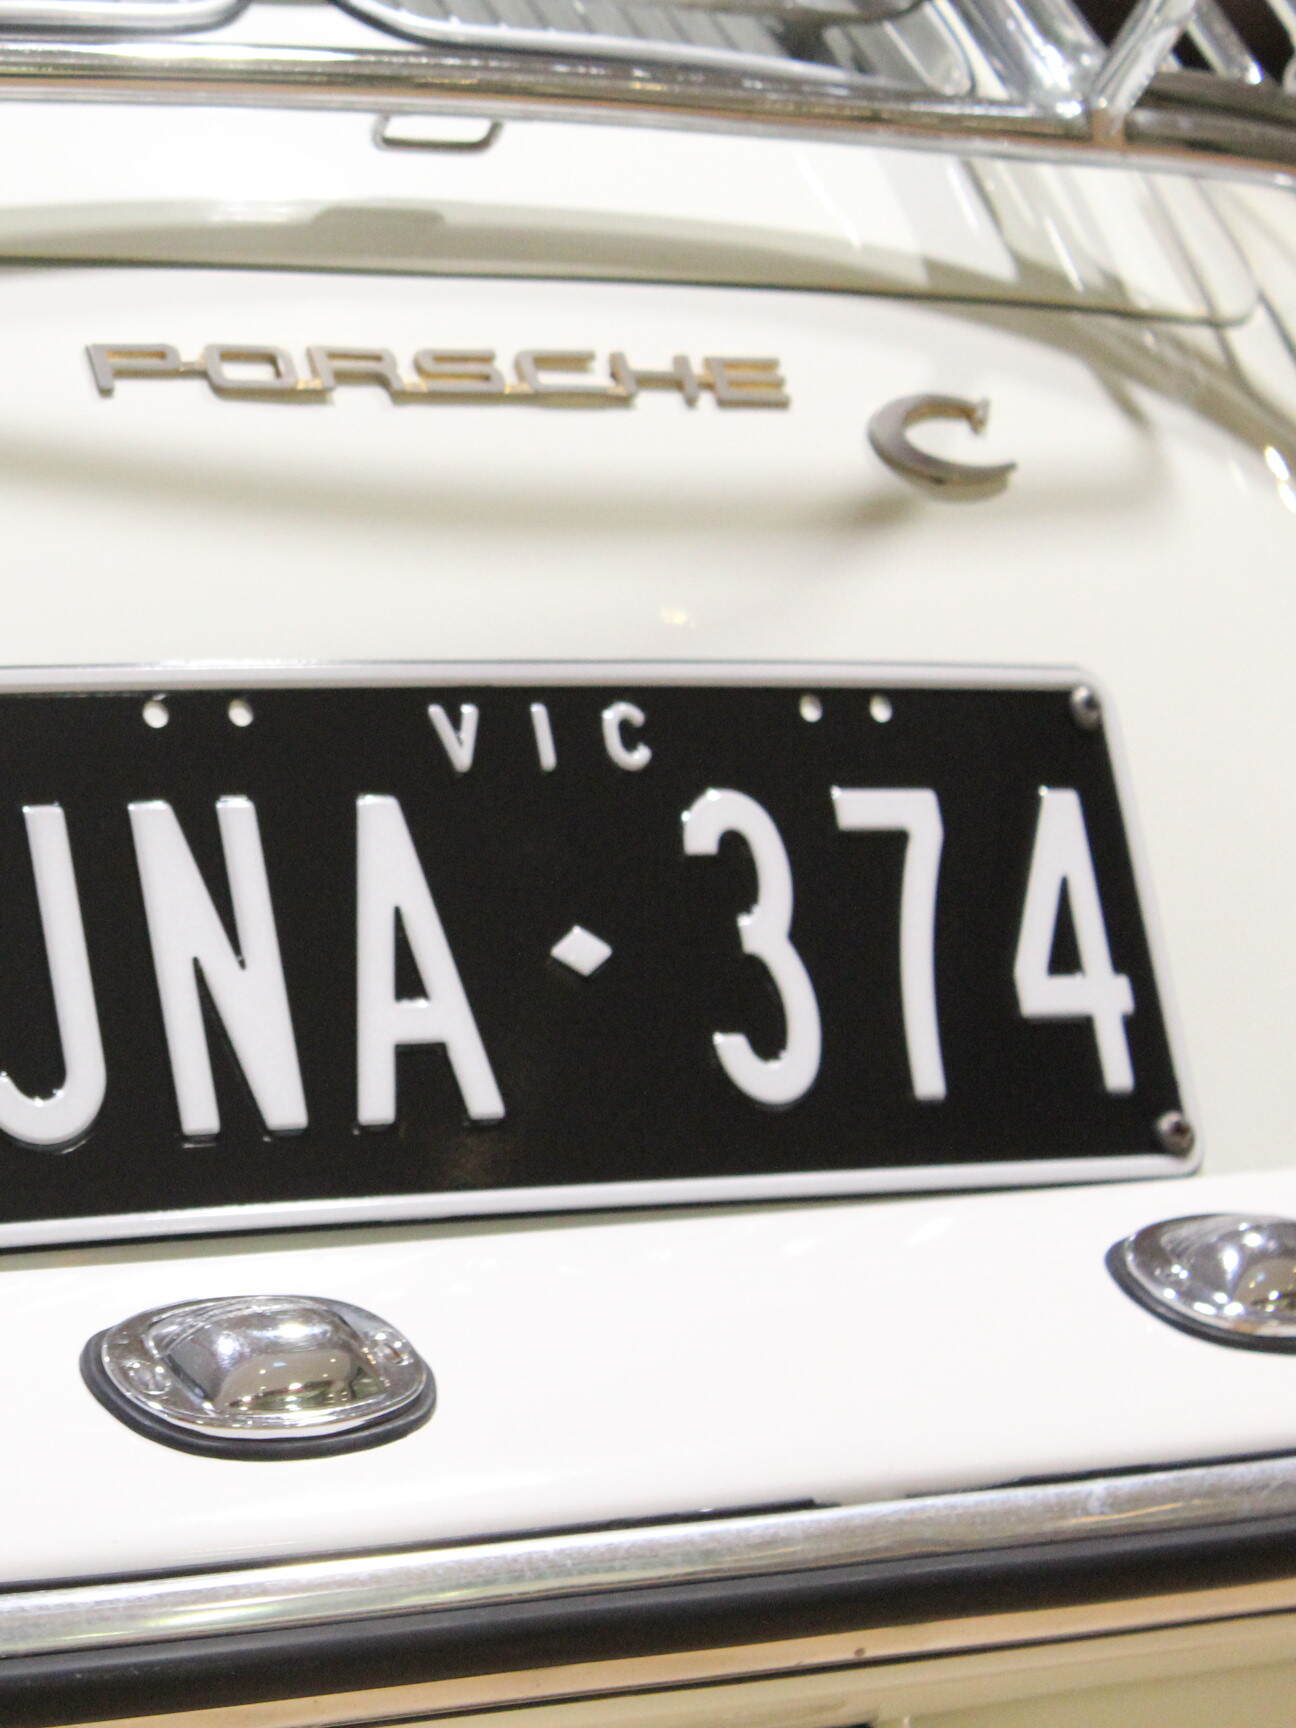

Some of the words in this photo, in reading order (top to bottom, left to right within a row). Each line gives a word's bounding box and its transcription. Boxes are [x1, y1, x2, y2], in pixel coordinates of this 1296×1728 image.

[86, 343, 791, 408] PORSCHE
[867, 393, 1018, 493] C
[426, 702, 654, 773] VIC
[683, 786, 1135, 1107] 374
